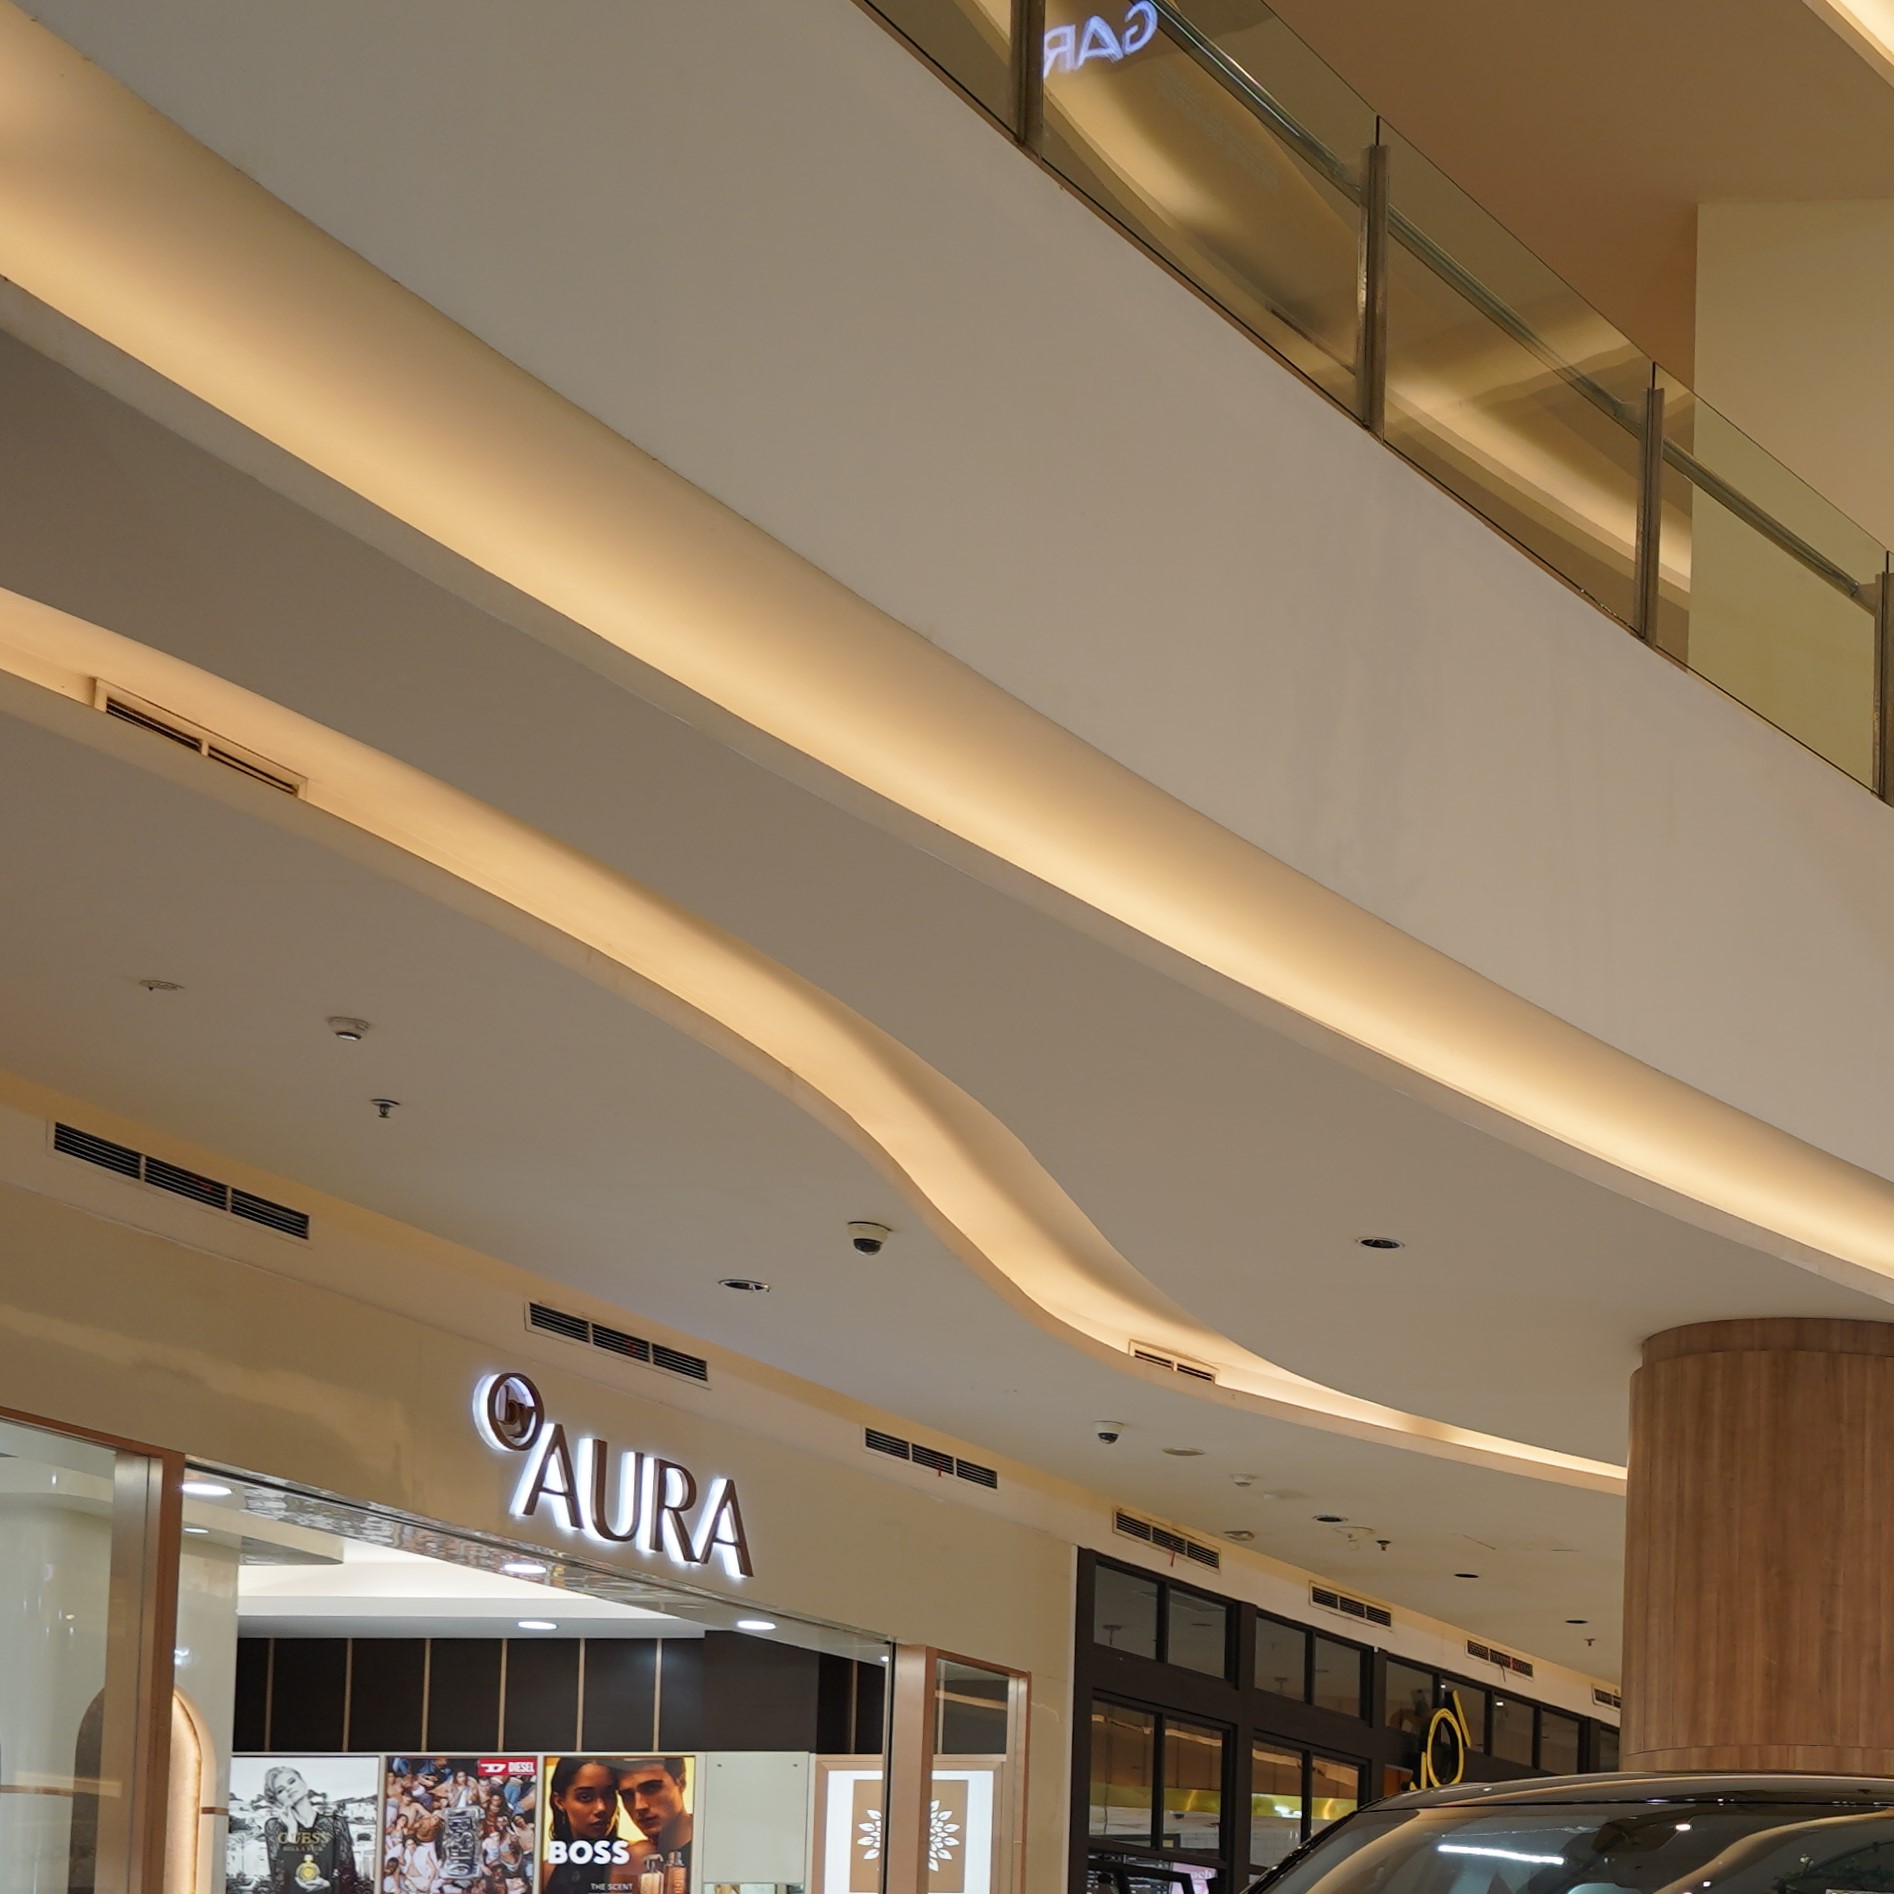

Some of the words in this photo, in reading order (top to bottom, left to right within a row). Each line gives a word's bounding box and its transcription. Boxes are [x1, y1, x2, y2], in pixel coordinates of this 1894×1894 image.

[509, 1422, 754, 1577] AURA
[508, 1761, 534, 1774] DIESEL
[548, 1840, 630, 1865] BOSS
